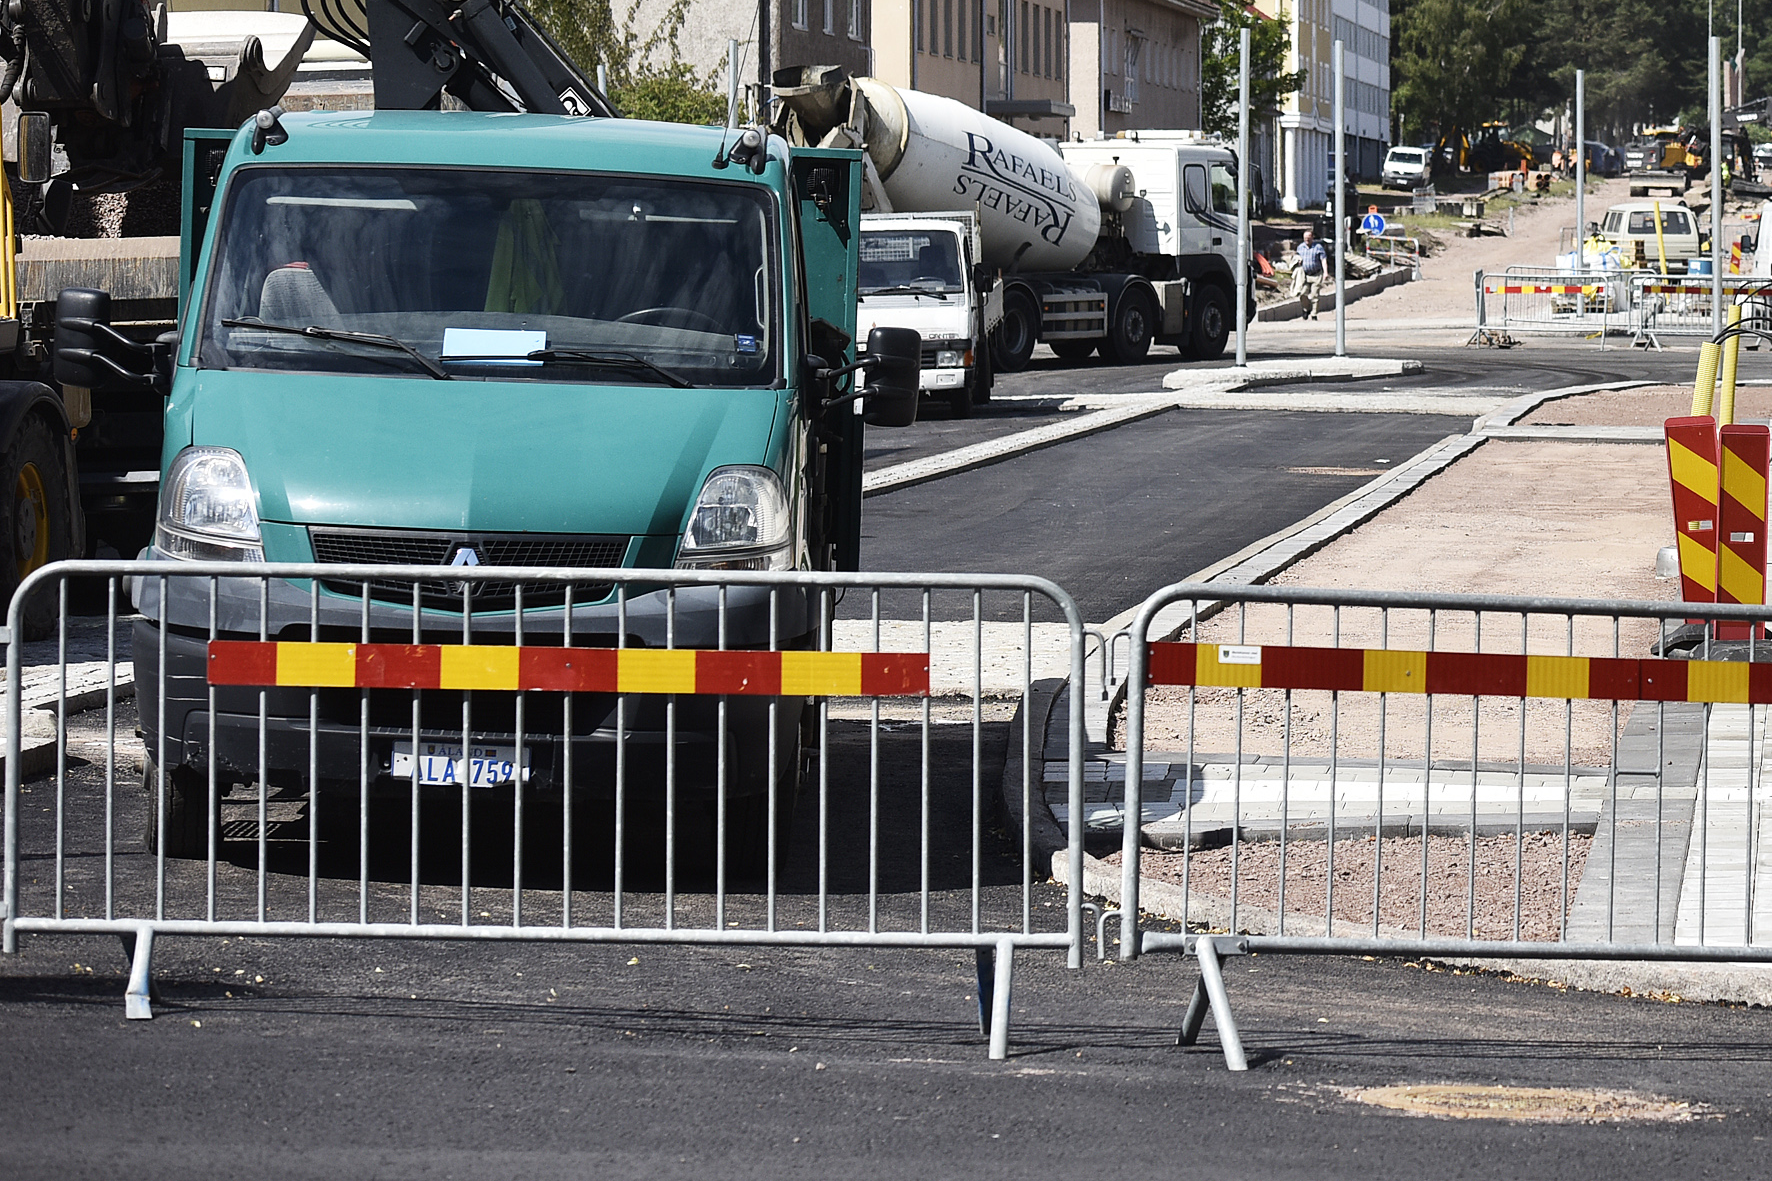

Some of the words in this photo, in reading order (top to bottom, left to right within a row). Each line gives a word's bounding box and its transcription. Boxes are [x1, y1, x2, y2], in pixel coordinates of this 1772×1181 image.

[961, 130, 1077, 203] RAFAELS
[438, 744, 483, 757] ÅLAD
[473, 759, 513, 784] 759
